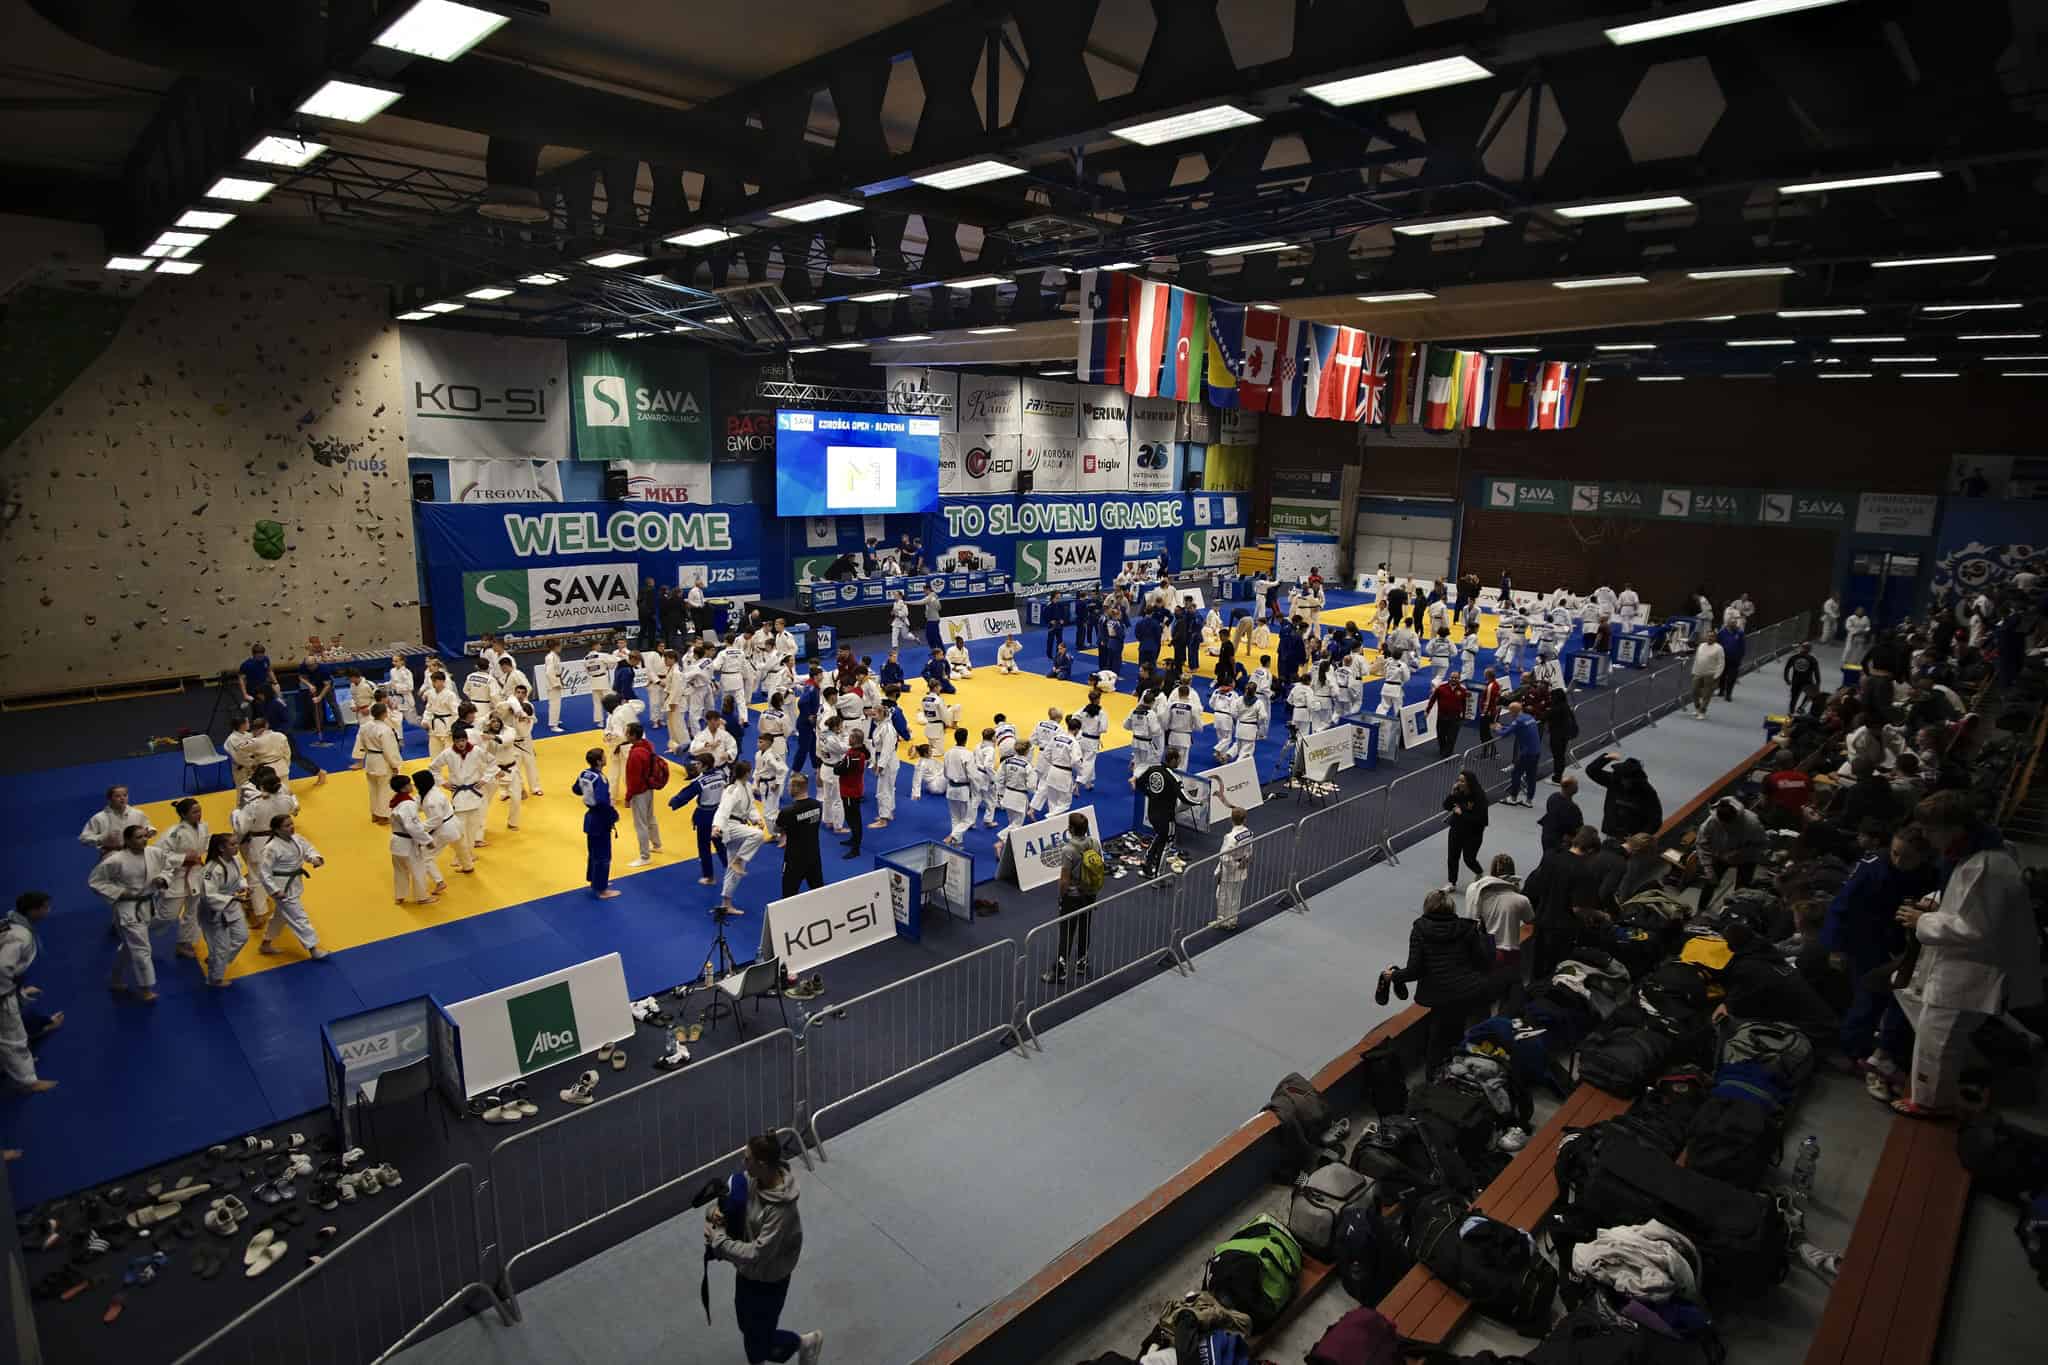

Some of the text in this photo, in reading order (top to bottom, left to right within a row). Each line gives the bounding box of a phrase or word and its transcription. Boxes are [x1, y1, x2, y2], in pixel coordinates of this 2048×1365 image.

[415, 381, 545, 415] KO-SI
[635, 388, 700, 413] SAVA
[473, 489, 542, 500] TRGOVIN
[644, 487, 688, 502] MKB
[1519, 488, 1554, 501] SAVA
[1603, 491, 1642, 505] SAVA
[1696, 495, 1737, 509] SAVA
[1797, 498, 1846, 514] SAVA
[946, 500, 1182, 537] TO SLOVENJ GRADEC
[505, 513, 731, 556] WELCOME
[1210, 536, 1241, 551] SAVA
[1054, 546, 1097, 566] SAVA
[709, 568, 735, 583] JZS
[544, 574, 629, 606] SAVA
[546, 604, 630, 619] ZAVAROVALNICA
[784, 902, 878, 956] KO-SI
[525, 1029, 575, 1064] Alba
